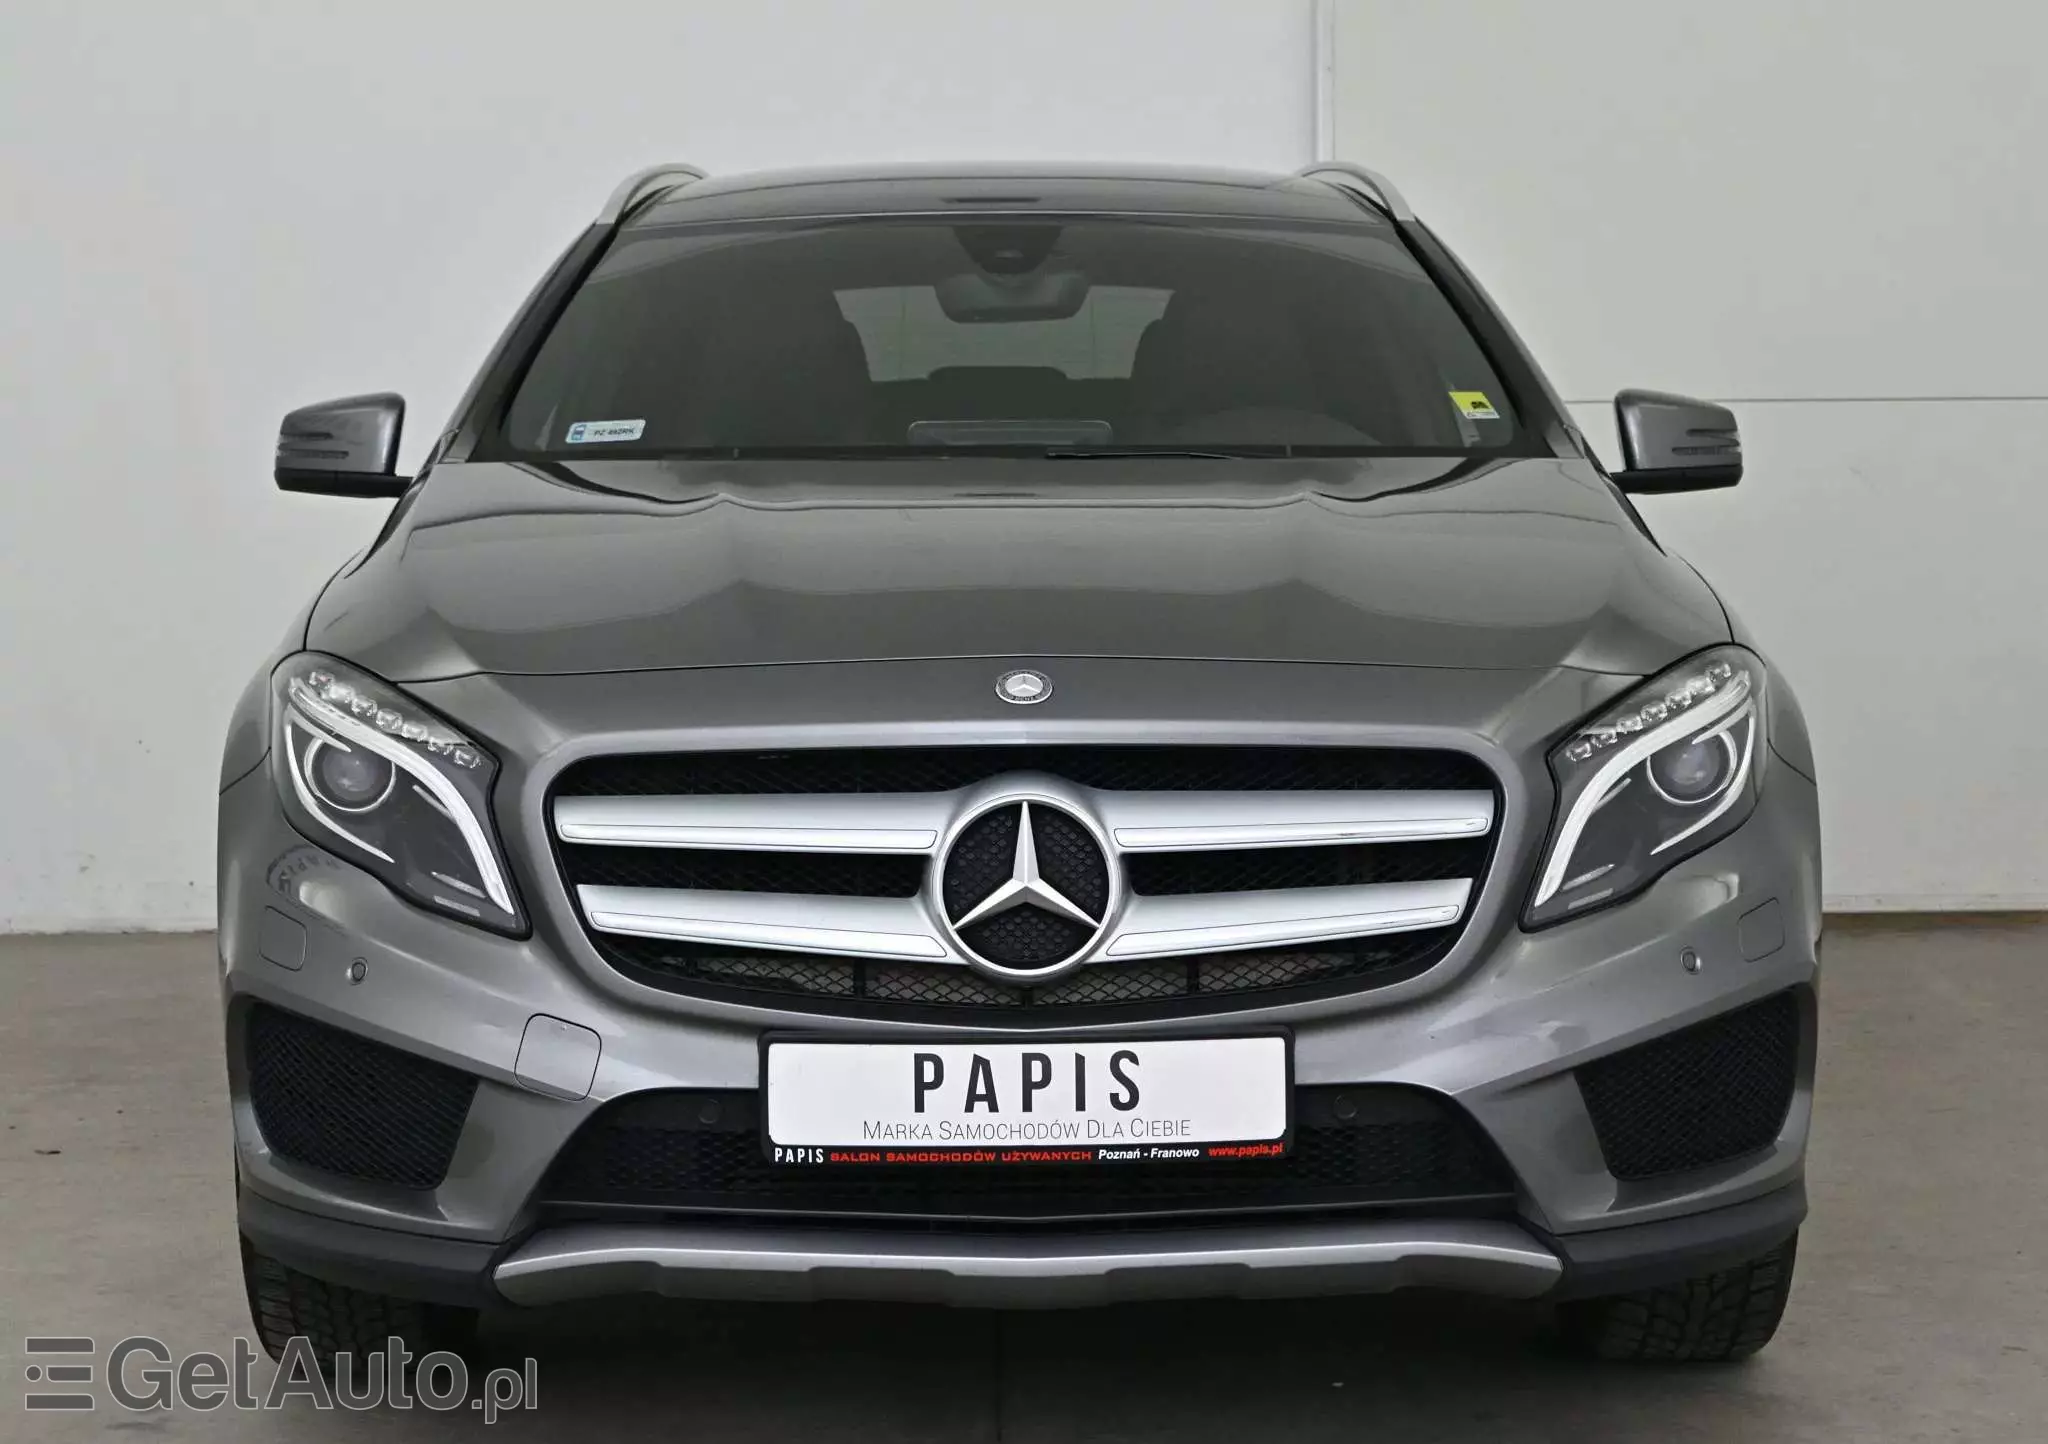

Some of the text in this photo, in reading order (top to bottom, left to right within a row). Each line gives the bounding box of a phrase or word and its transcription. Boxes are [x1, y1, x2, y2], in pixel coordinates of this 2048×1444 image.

[913, 1049, 1140, 1114] PAPIS
[863, 1117, 1191, 1140] MARKA SAMOCHODÓW DLA CIEBIE
[774, 1147, 824, 1163] PAPIS
[829, 1151, 881, 1162] SALON
[886, 1149, 996, 1162] SAMOCHODÓW
[1001, 1150, 1092, 1162] UŻYWANYCH
[1098, 1147, 1141, 1160] Poznań
[1150, 1147, 1200, 1159] Franowo
[1207, 1142, 1285, 1157] www.papis.pl
